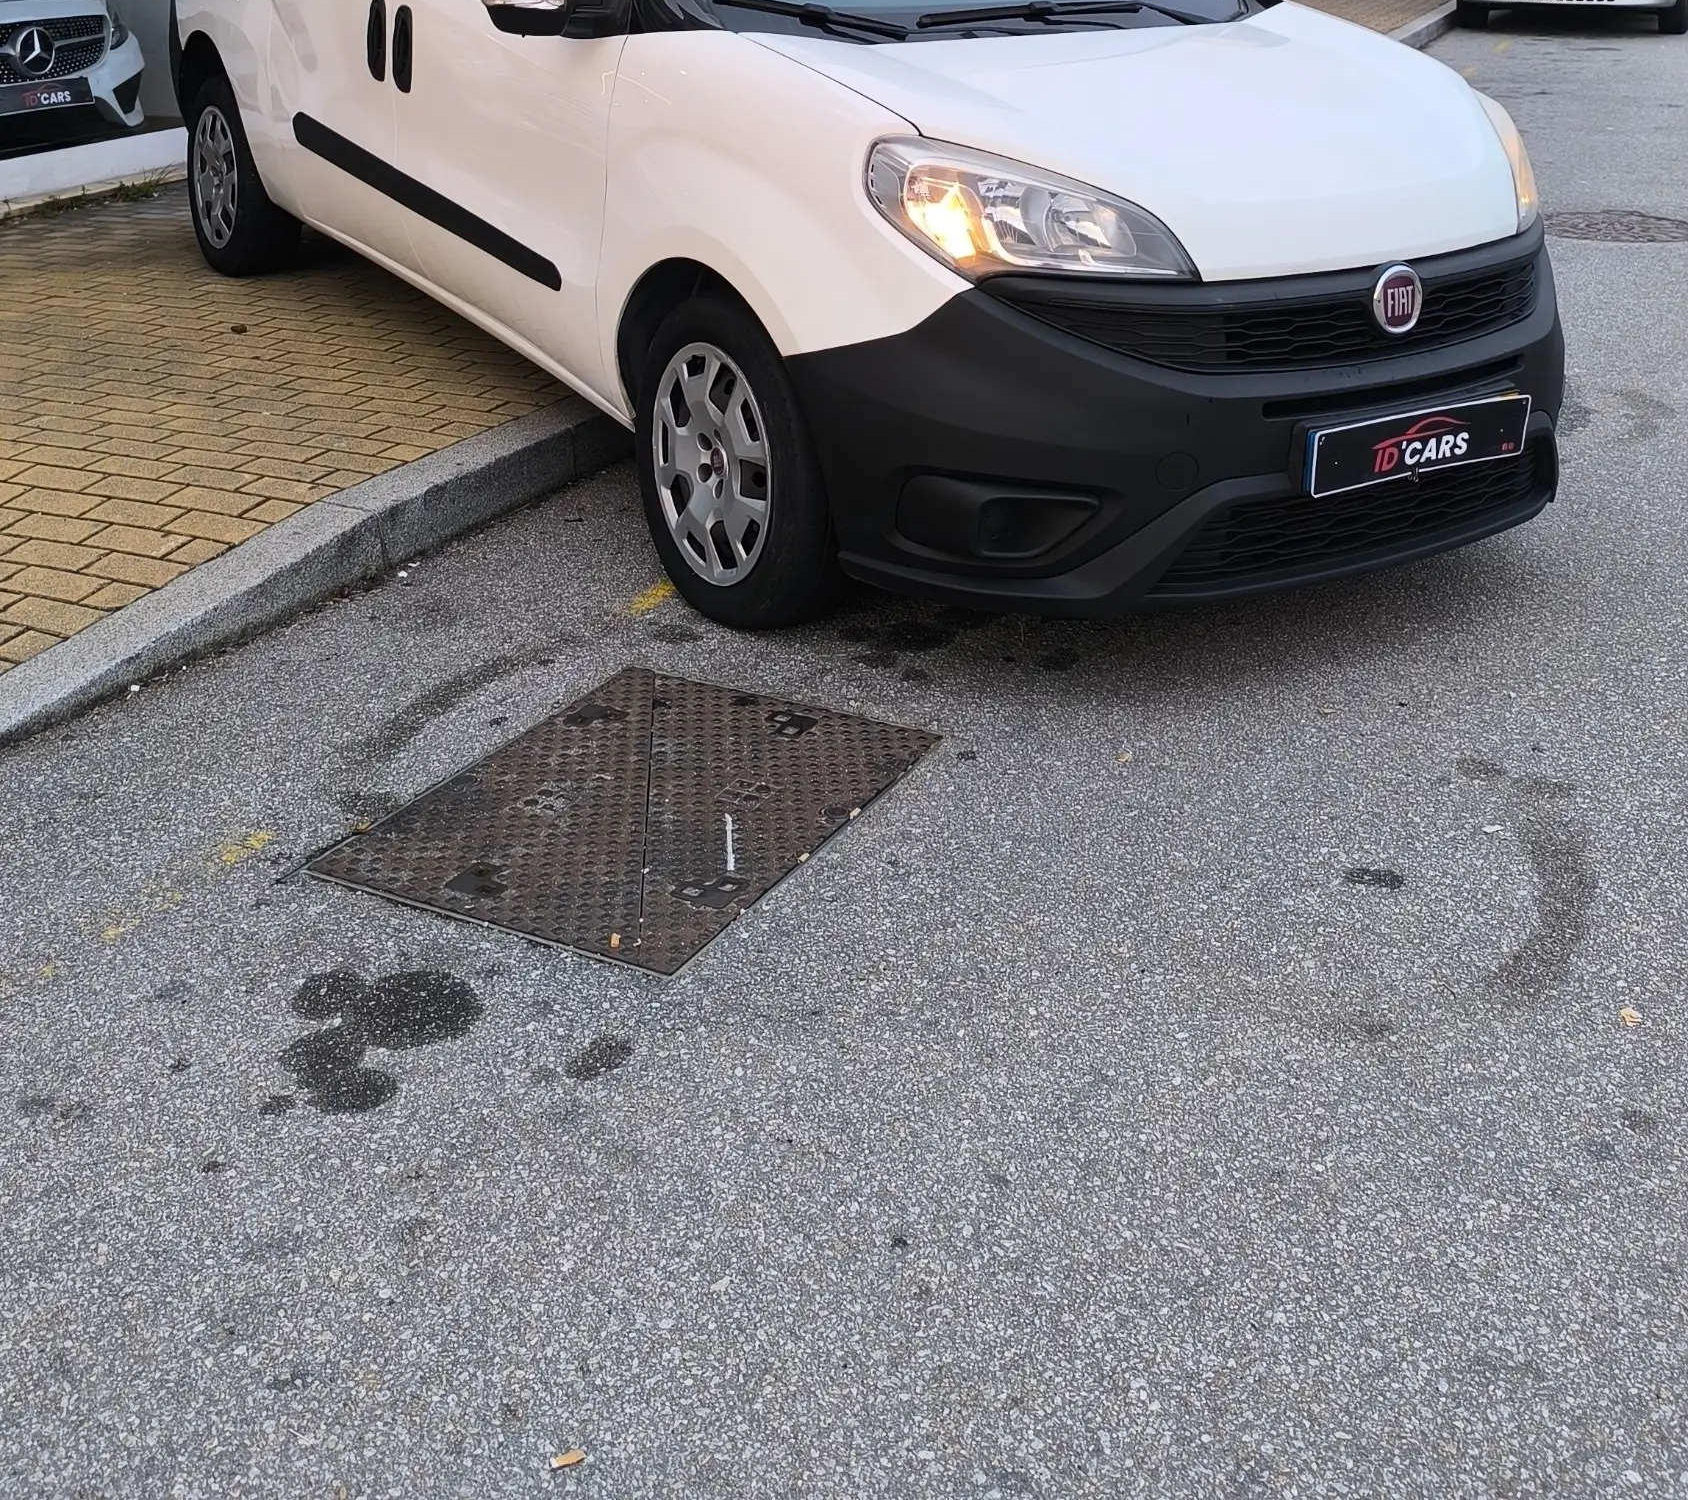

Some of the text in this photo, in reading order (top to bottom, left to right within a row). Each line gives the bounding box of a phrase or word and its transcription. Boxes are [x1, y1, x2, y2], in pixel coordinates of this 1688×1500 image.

[25, 90, 72, 108] ID'CARS
[1386, 284, 1414, 318] FIAT
[1374, 431, 1470, 473] ID'CARS
